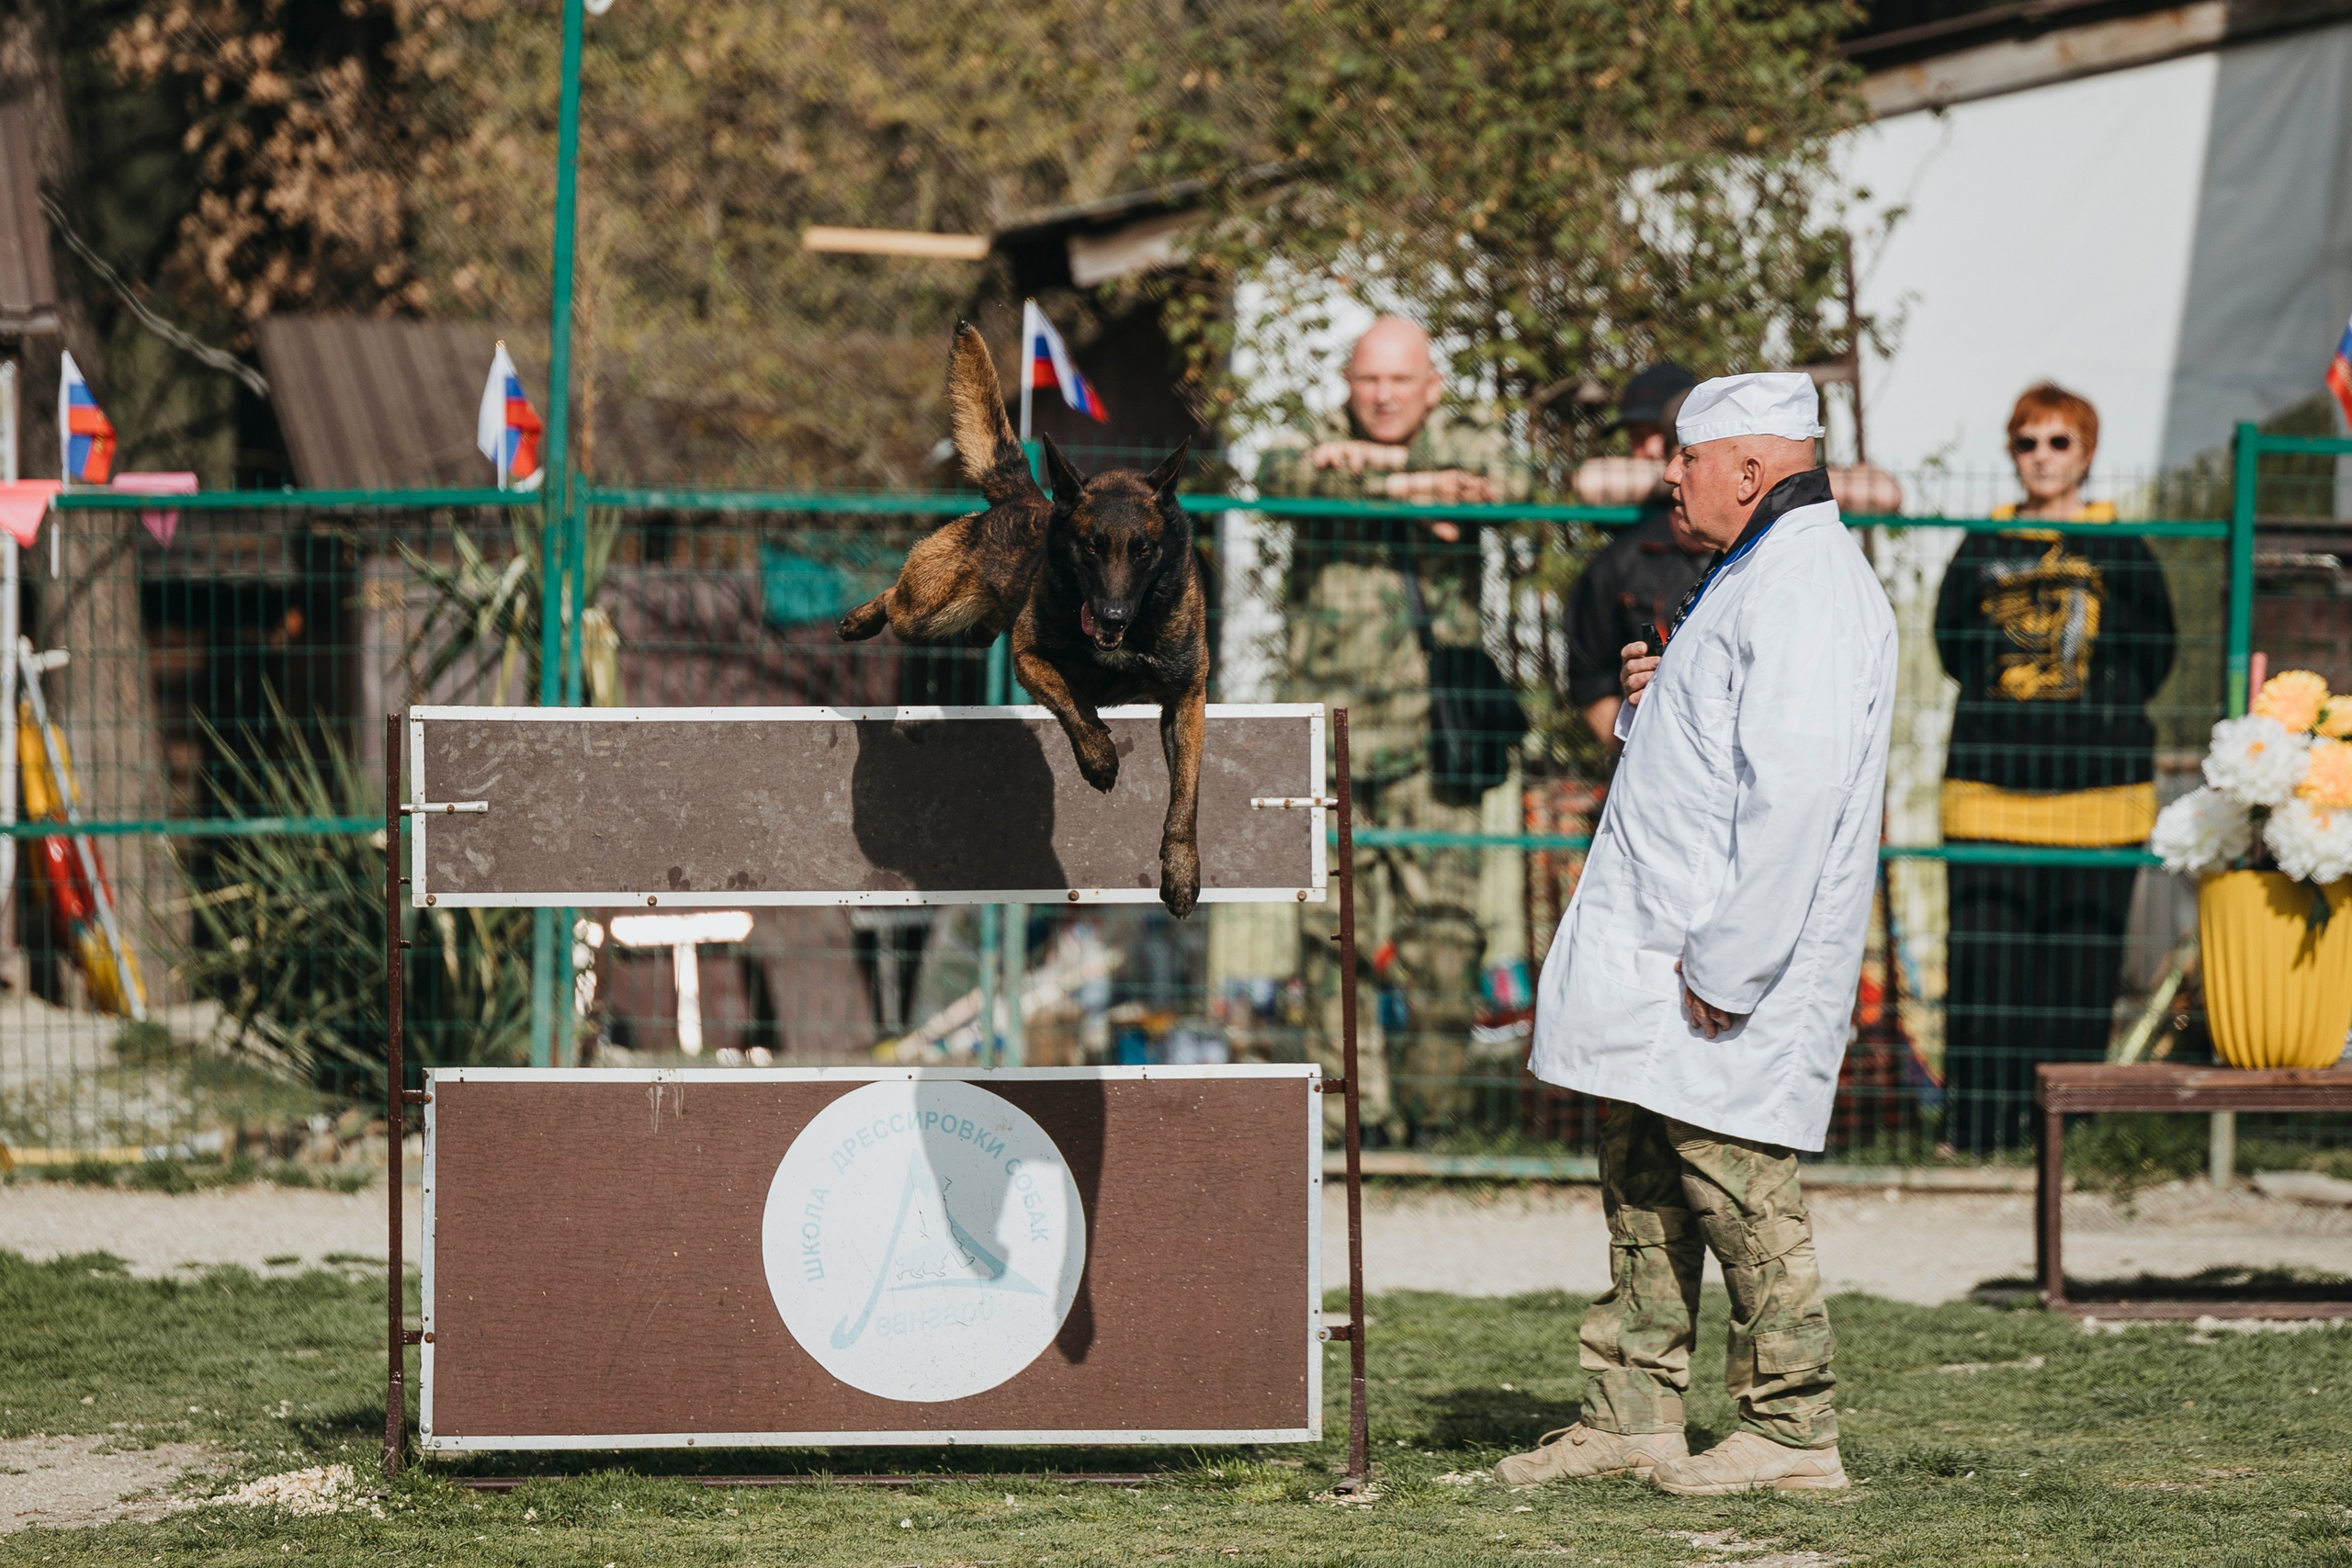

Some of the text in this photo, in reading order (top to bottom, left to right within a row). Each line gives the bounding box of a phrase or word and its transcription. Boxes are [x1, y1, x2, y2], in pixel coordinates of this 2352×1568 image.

[801, 1111, 1049, 1282] ШКОЛА ДРЕССИРОВКИ СОБАК
